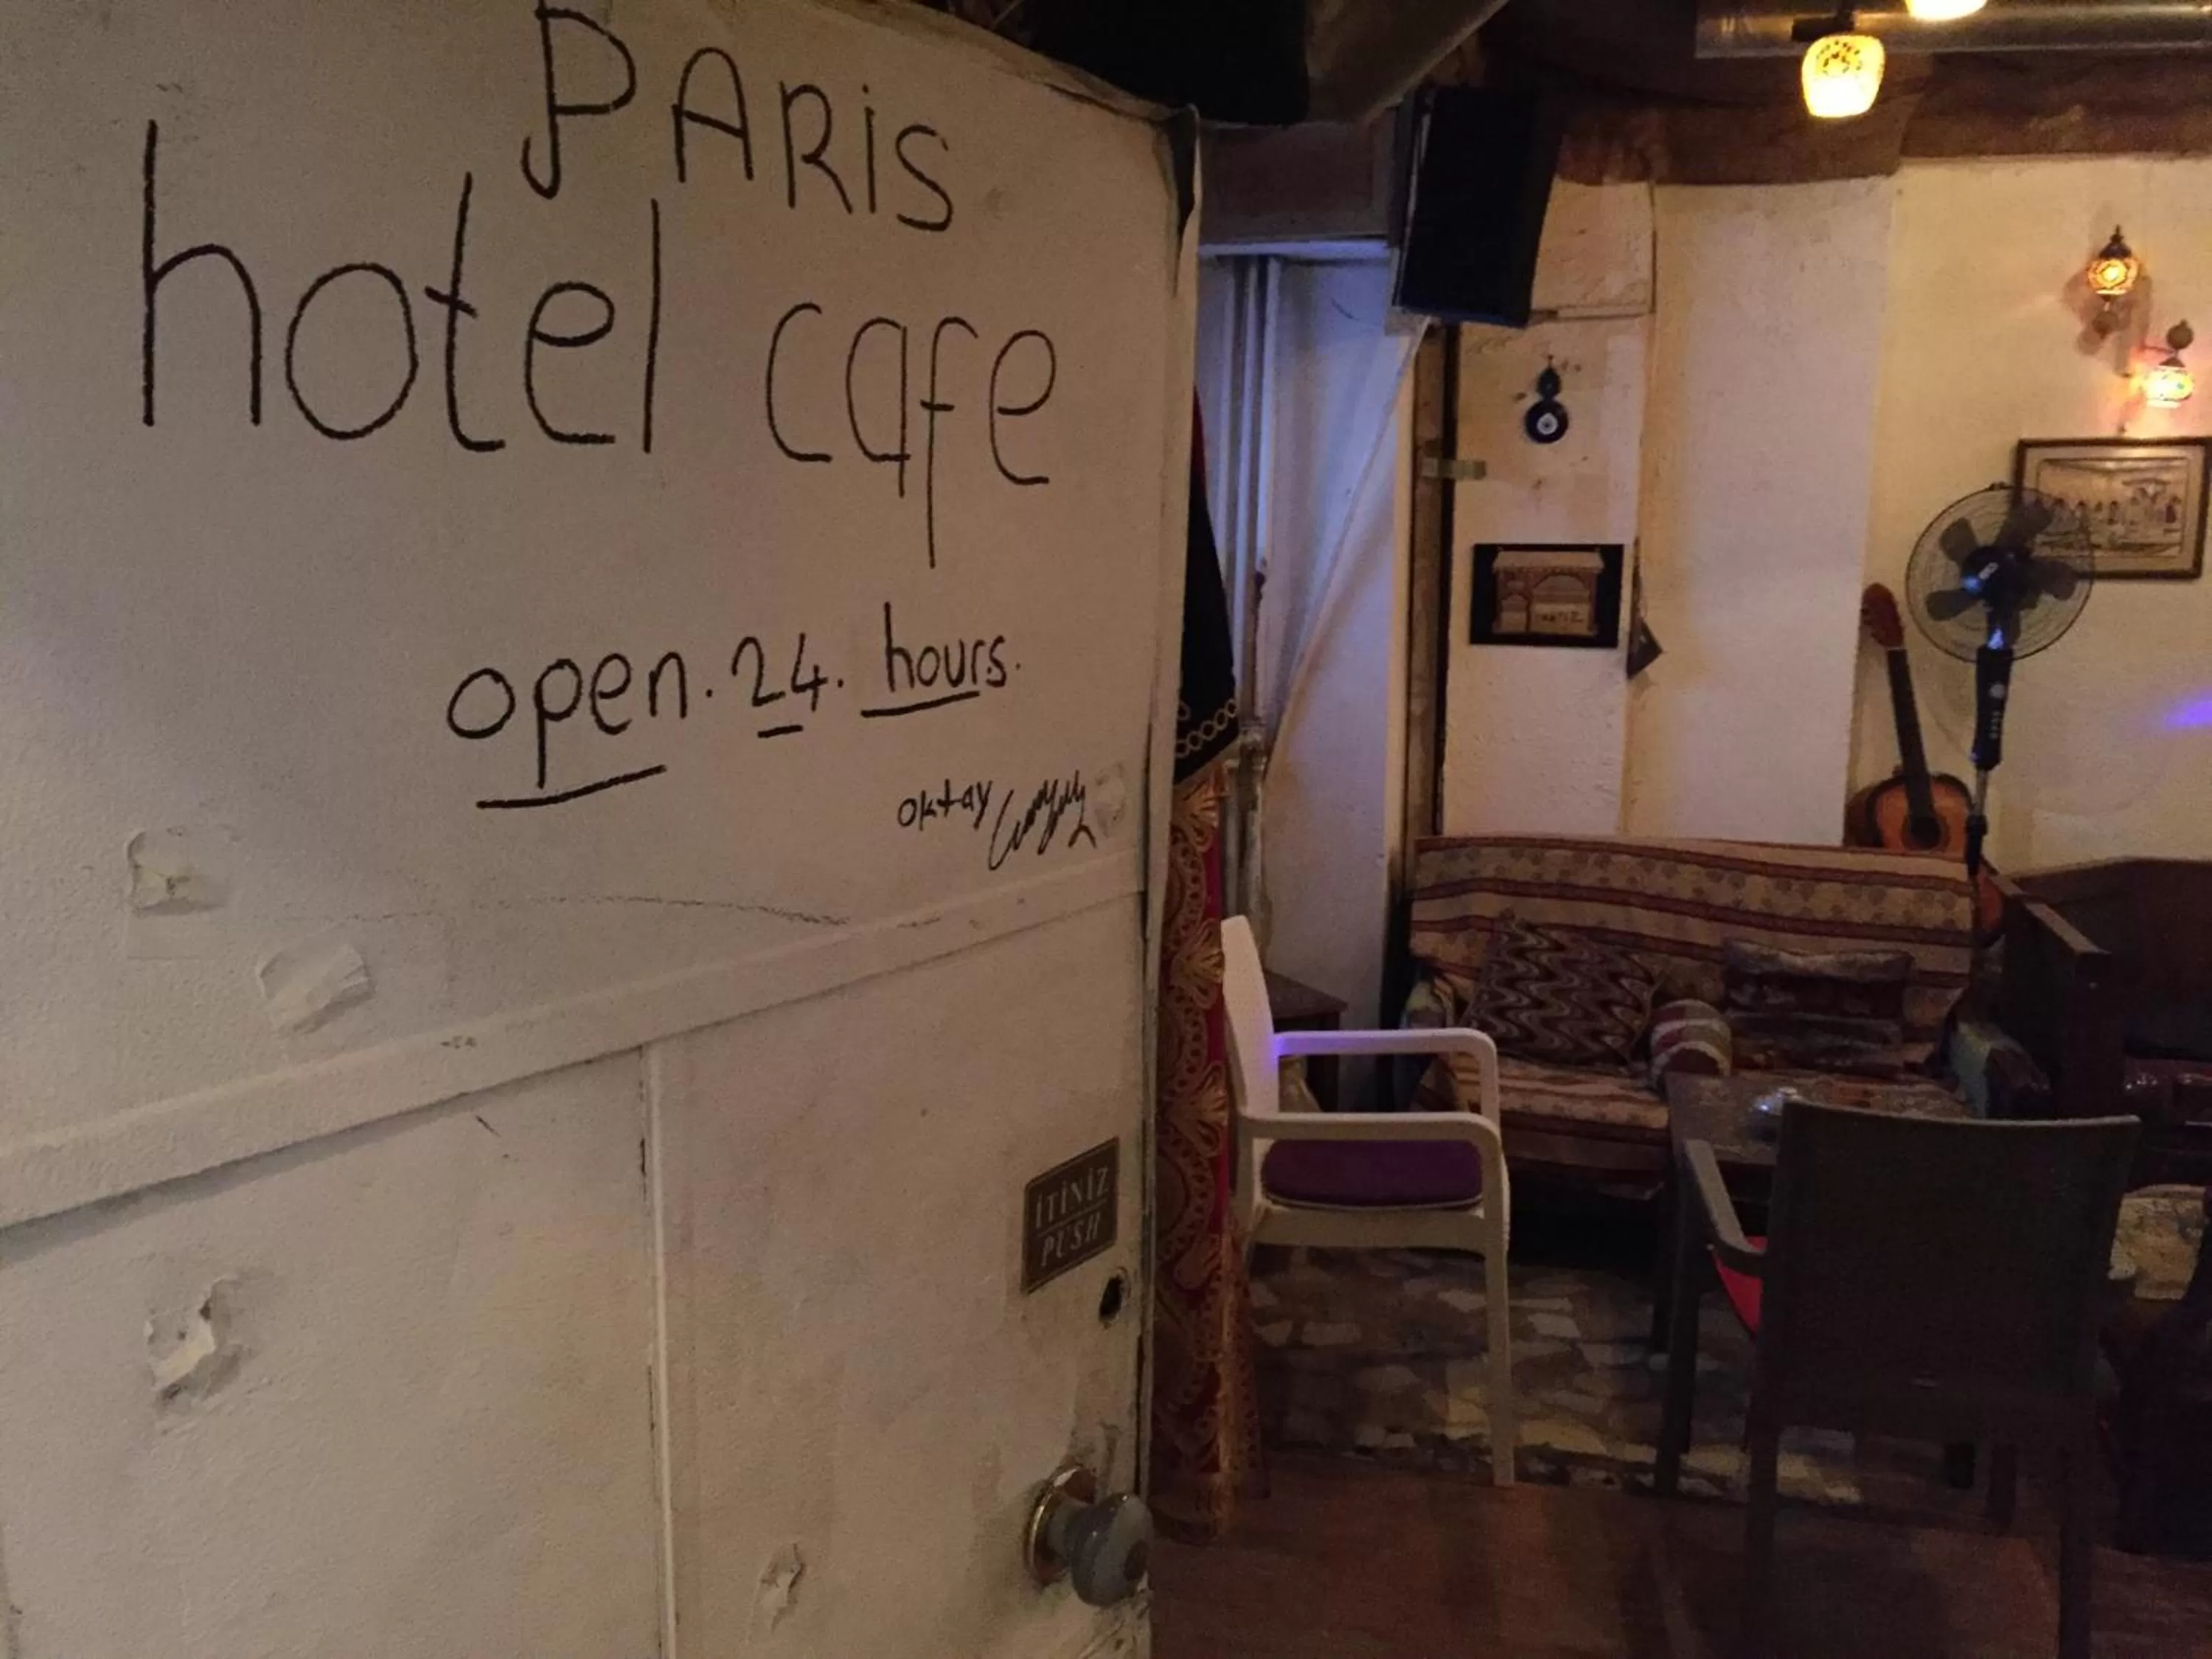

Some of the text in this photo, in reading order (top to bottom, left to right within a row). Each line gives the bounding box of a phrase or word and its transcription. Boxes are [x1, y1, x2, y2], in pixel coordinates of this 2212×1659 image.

[142, 119, 1057, 569] hotel cafe
[1040, 1210, 1102, 1268] PUSH
